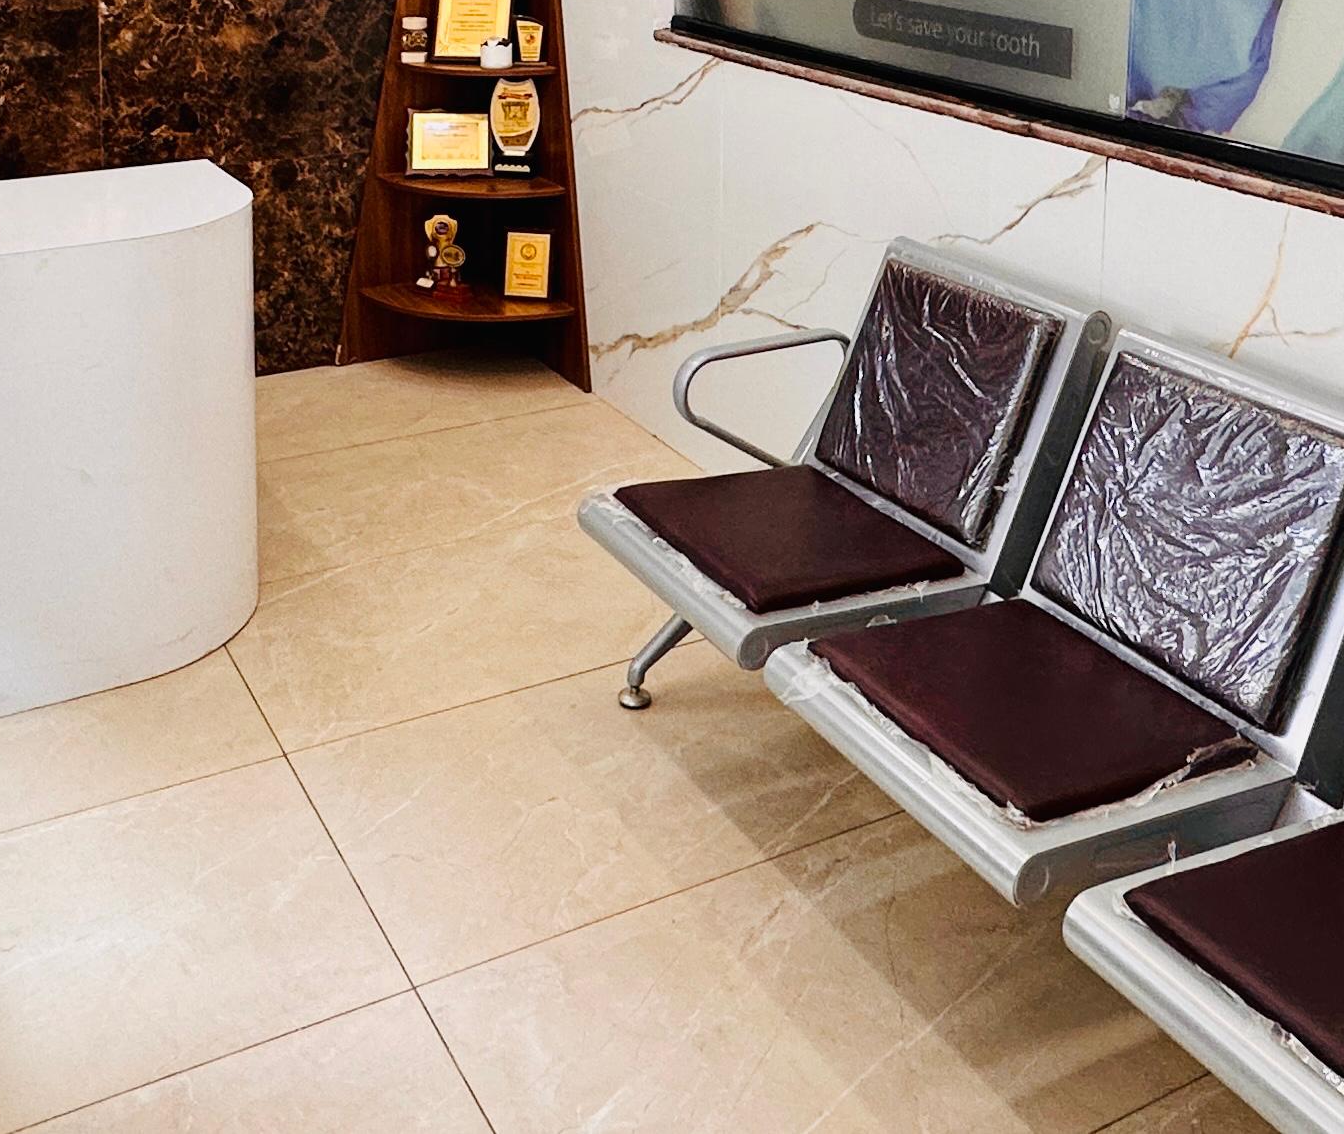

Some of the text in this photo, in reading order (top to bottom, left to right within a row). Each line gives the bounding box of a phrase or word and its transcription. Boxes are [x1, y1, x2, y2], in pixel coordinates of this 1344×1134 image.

[870, 5, 1040, 59] Let's save your tooth
